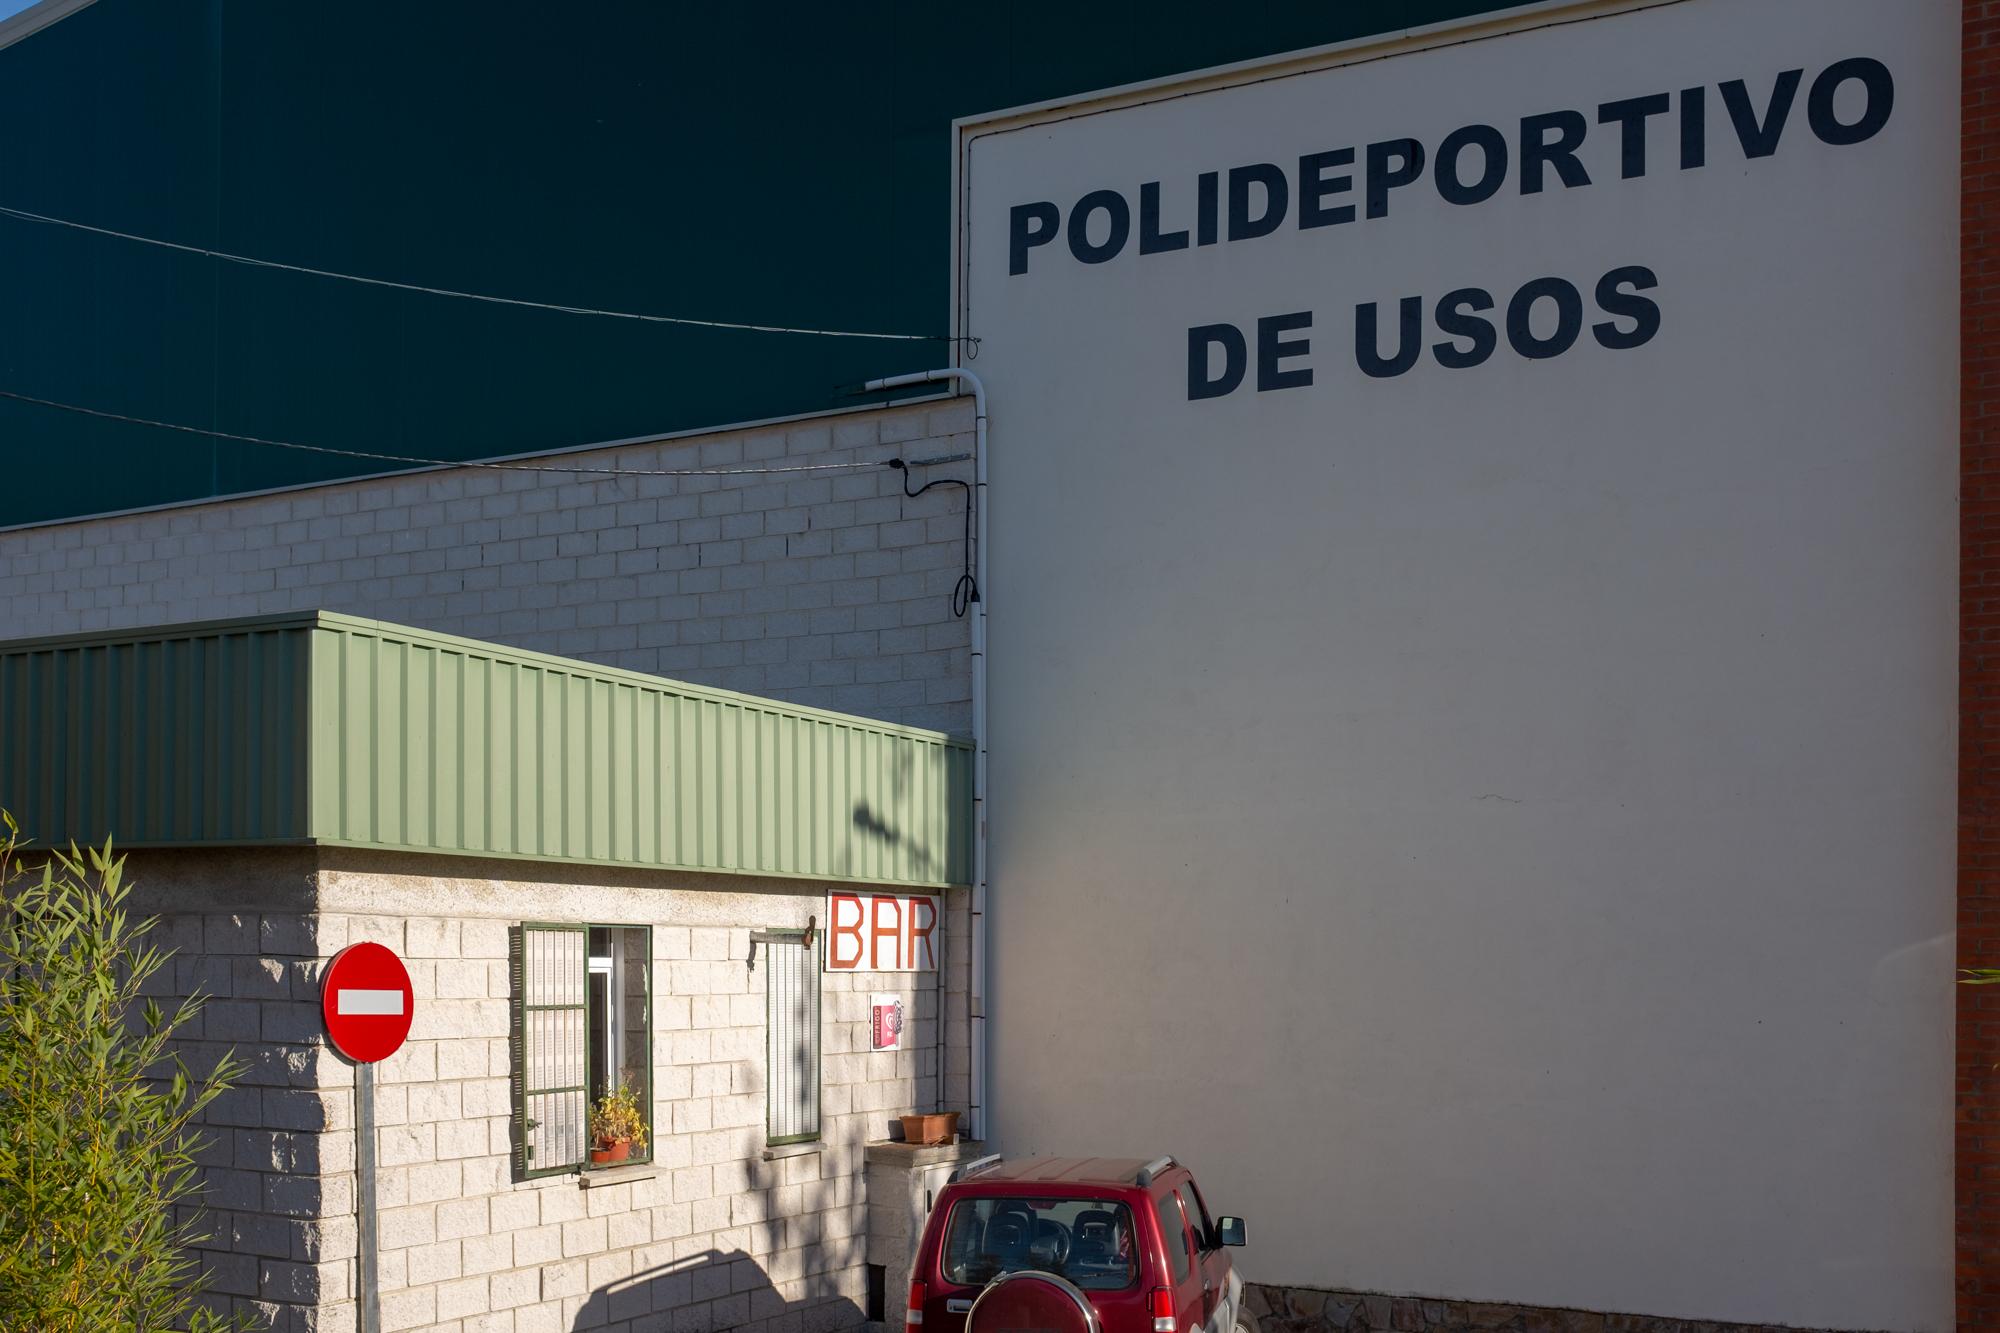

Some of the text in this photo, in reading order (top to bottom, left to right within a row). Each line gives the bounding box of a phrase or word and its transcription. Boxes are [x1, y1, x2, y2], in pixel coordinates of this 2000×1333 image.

[1009, 57, 1895, 277] POLIDEPORTIVO
[1188, 266, 1661, 402] DE USOS
[831, 892, 937, 969] BAR
